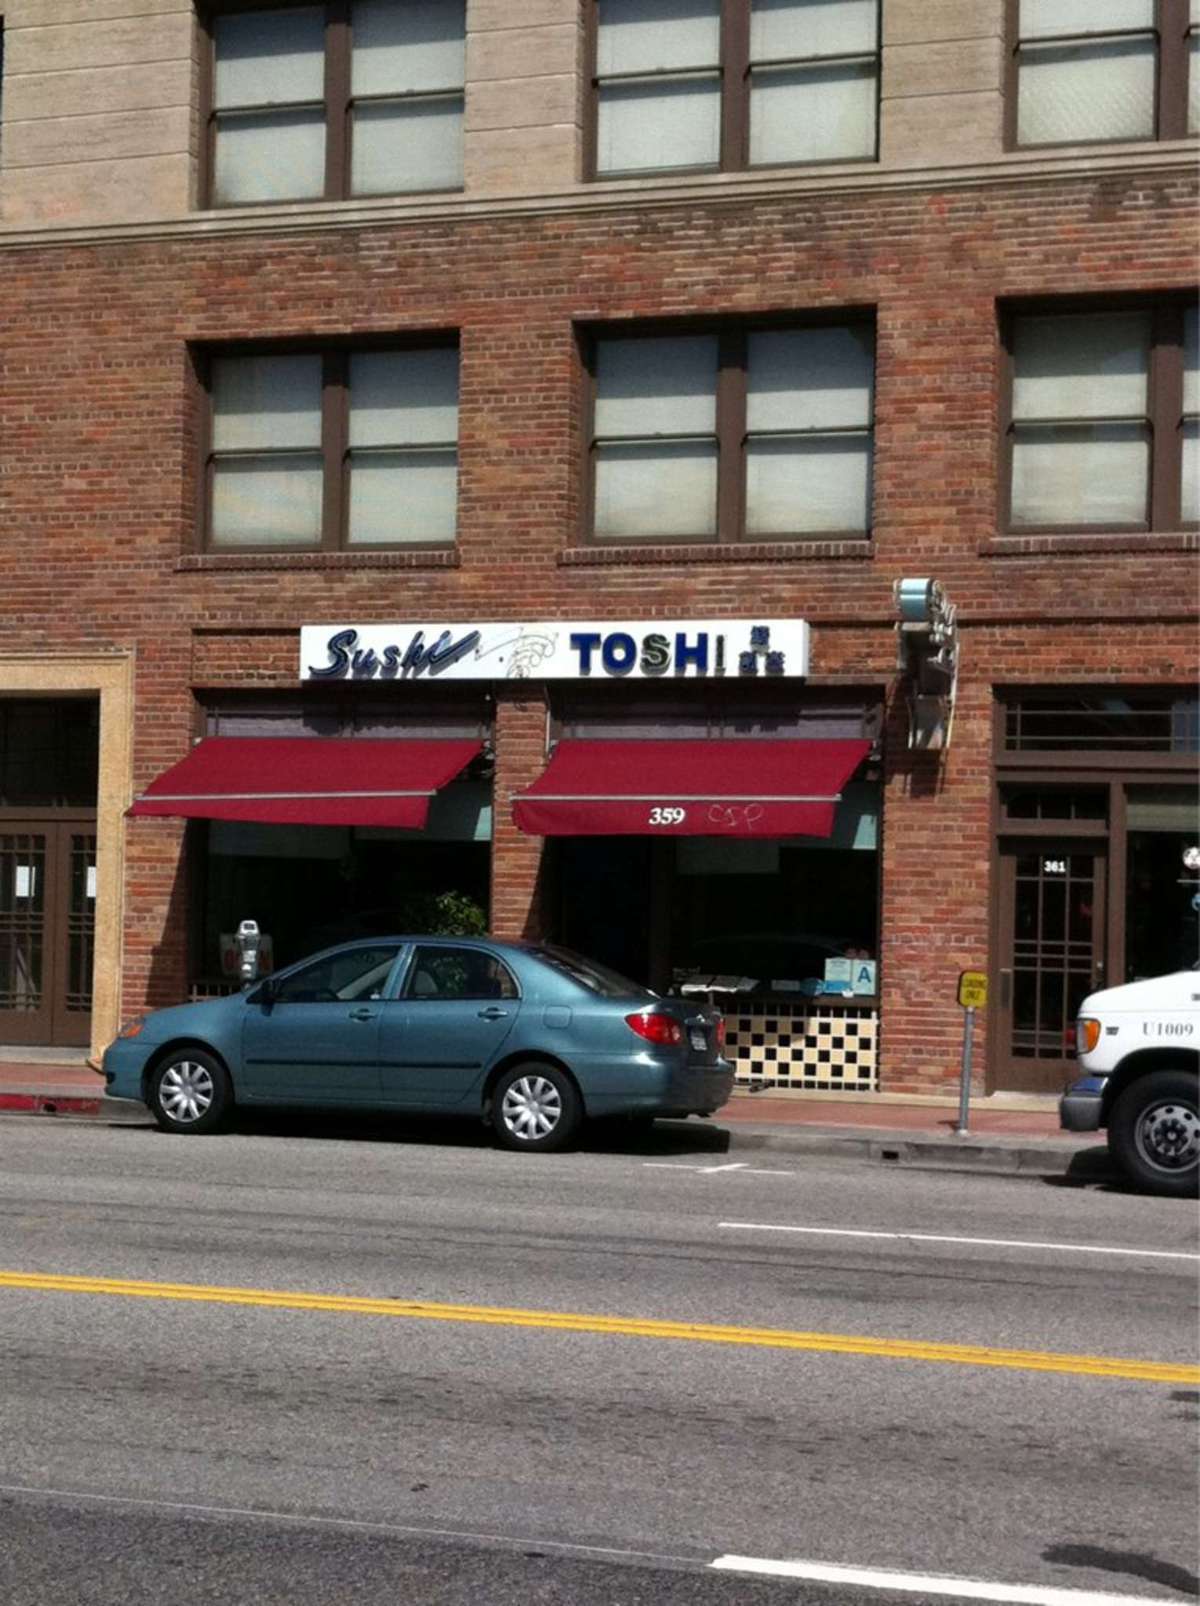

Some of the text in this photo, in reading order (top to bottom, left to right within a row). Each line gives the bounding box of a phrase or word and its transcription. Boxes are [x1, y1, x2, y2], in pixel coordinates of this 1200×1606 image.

[308, 628, 481, 677] Sushi
[570, 632, 725, 677] TOSHI
[649, 807, 686, 825] 359
[1044, 860, 1066, 873] 361
[857, 966, 872, 983] A
